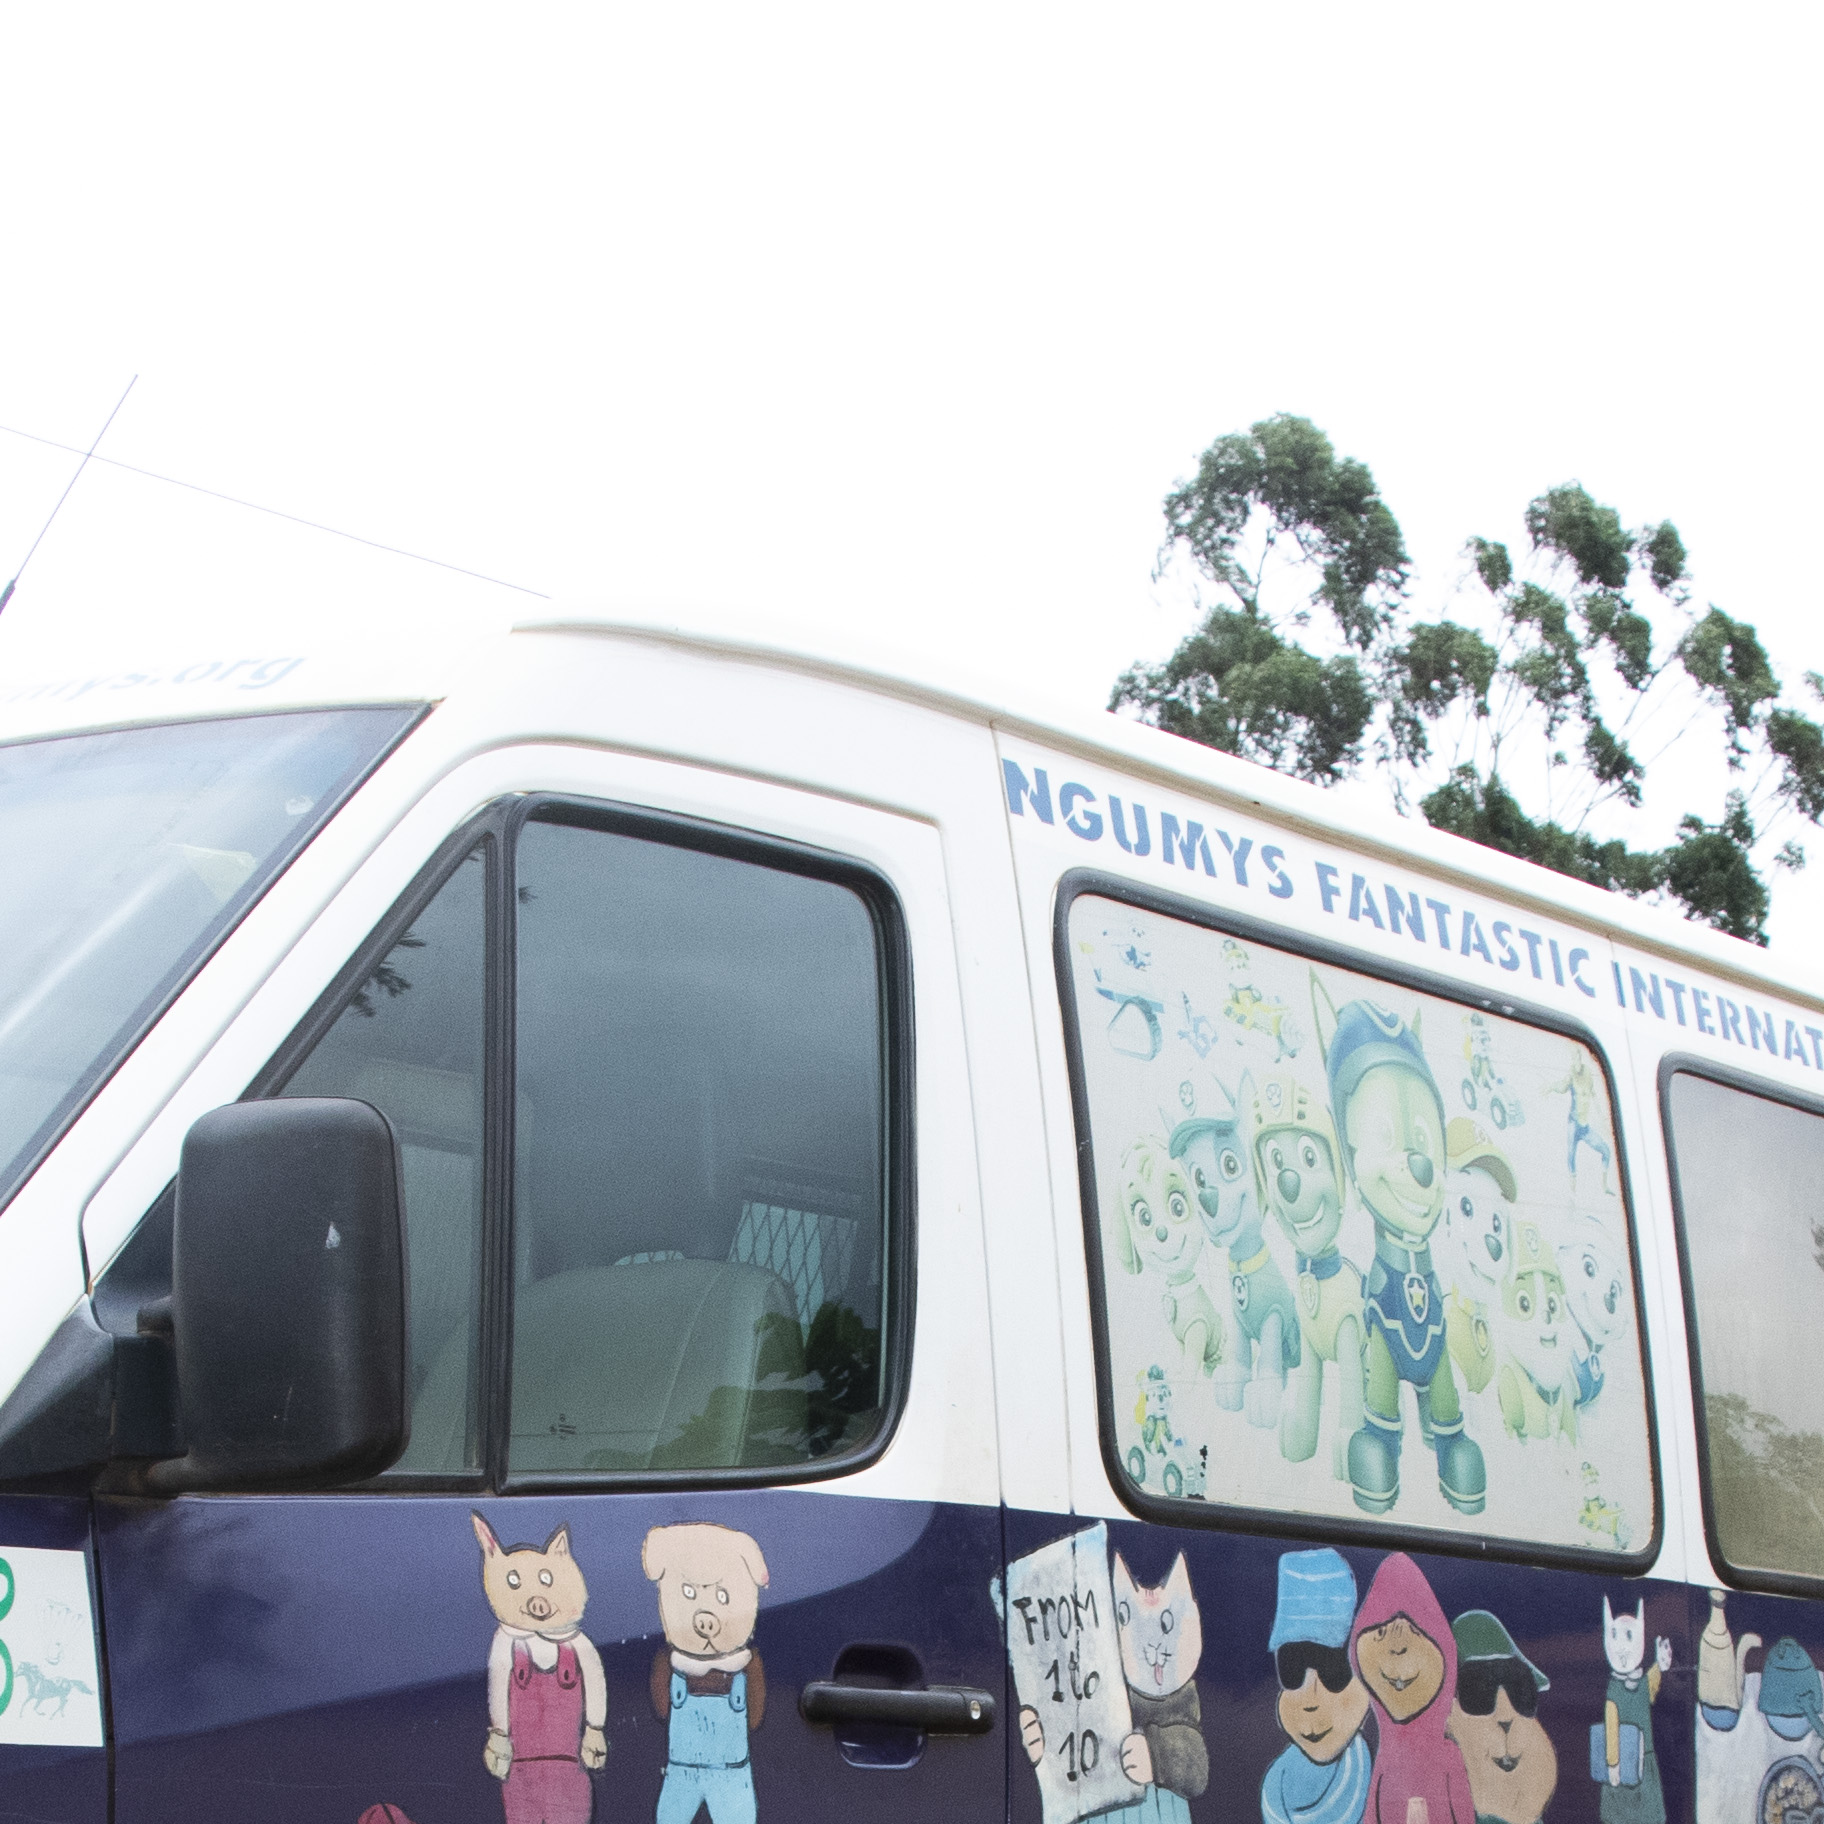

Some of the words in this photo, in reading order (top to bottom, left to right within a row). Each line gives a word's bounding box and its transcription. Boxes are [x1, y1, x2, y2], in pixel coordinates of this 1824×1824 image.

[1001, 758, 1294, 899] NGUMYS
[1314, 861, 1596, 999] FANTASTIC
[1059, 1729, 1099, 1783] 10
